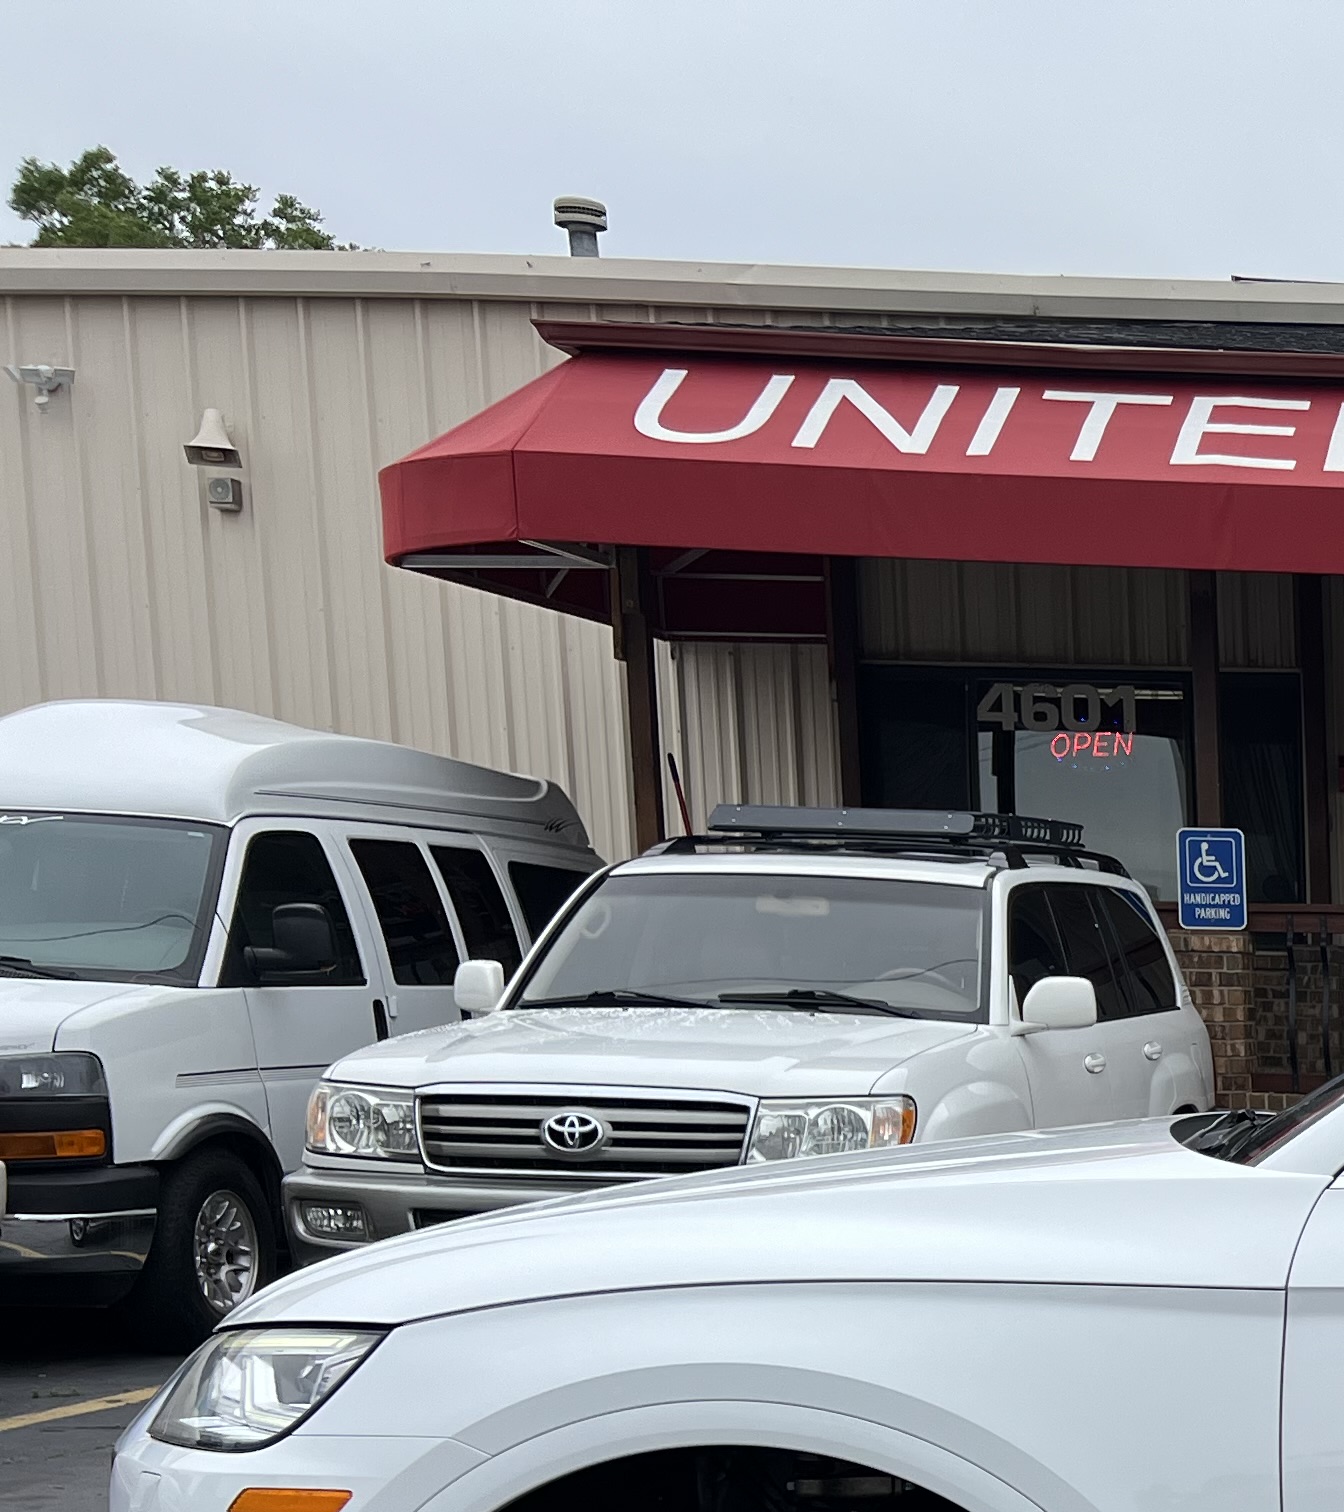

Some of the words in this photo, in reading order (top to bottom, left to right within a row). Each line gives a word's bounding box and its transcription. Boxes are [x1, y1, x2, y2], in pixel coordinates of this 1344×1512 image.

[977, 683, 1136, 732] 4601
[1050, 731, 1133, 758] OPEN
[1184, 893, 1241, 905] HANDICAPPED
[1195, 907, 1231, 920] PARKING
